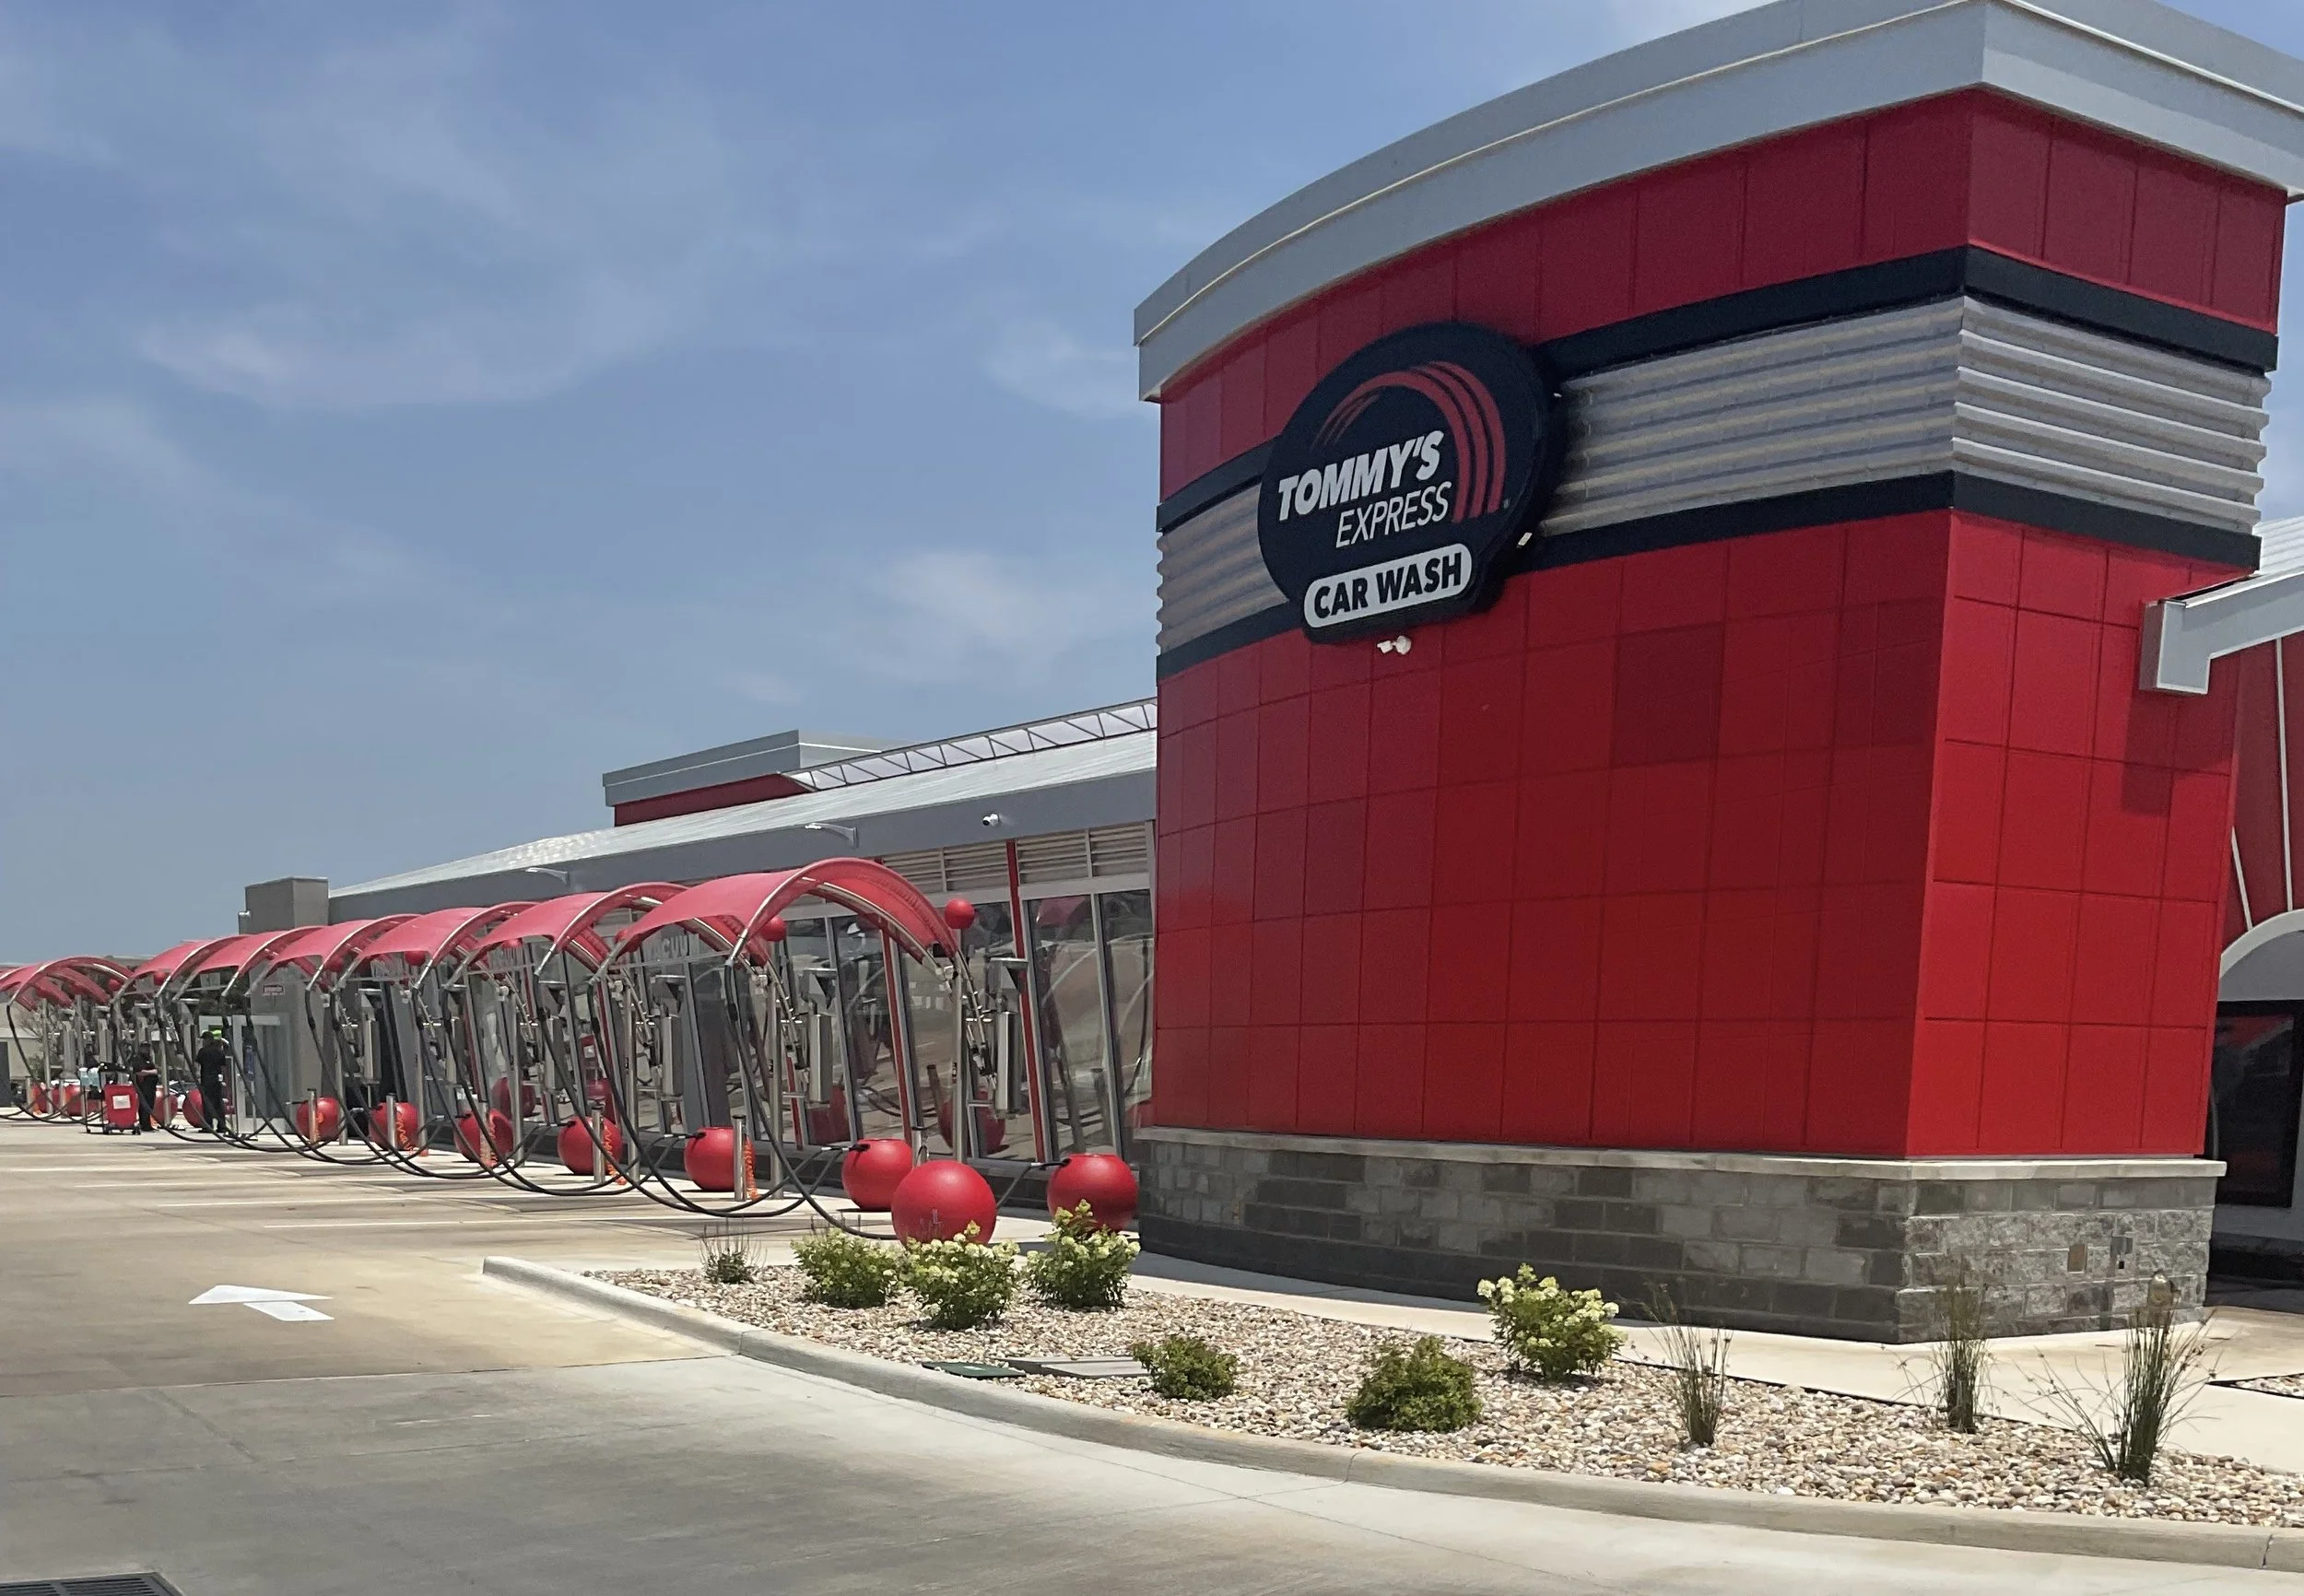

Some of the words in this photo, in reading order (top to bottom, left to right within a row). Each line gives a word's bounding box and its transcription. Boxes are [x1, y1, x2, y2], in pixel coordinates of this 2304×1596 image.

[1278, 430, 1444, 522] TOMMY'S
[1336, 482, 1452, 548] EXPRESS
[1314, 577, 1369, 618] CAR
[1377, 552, 1462, 604] WASH
